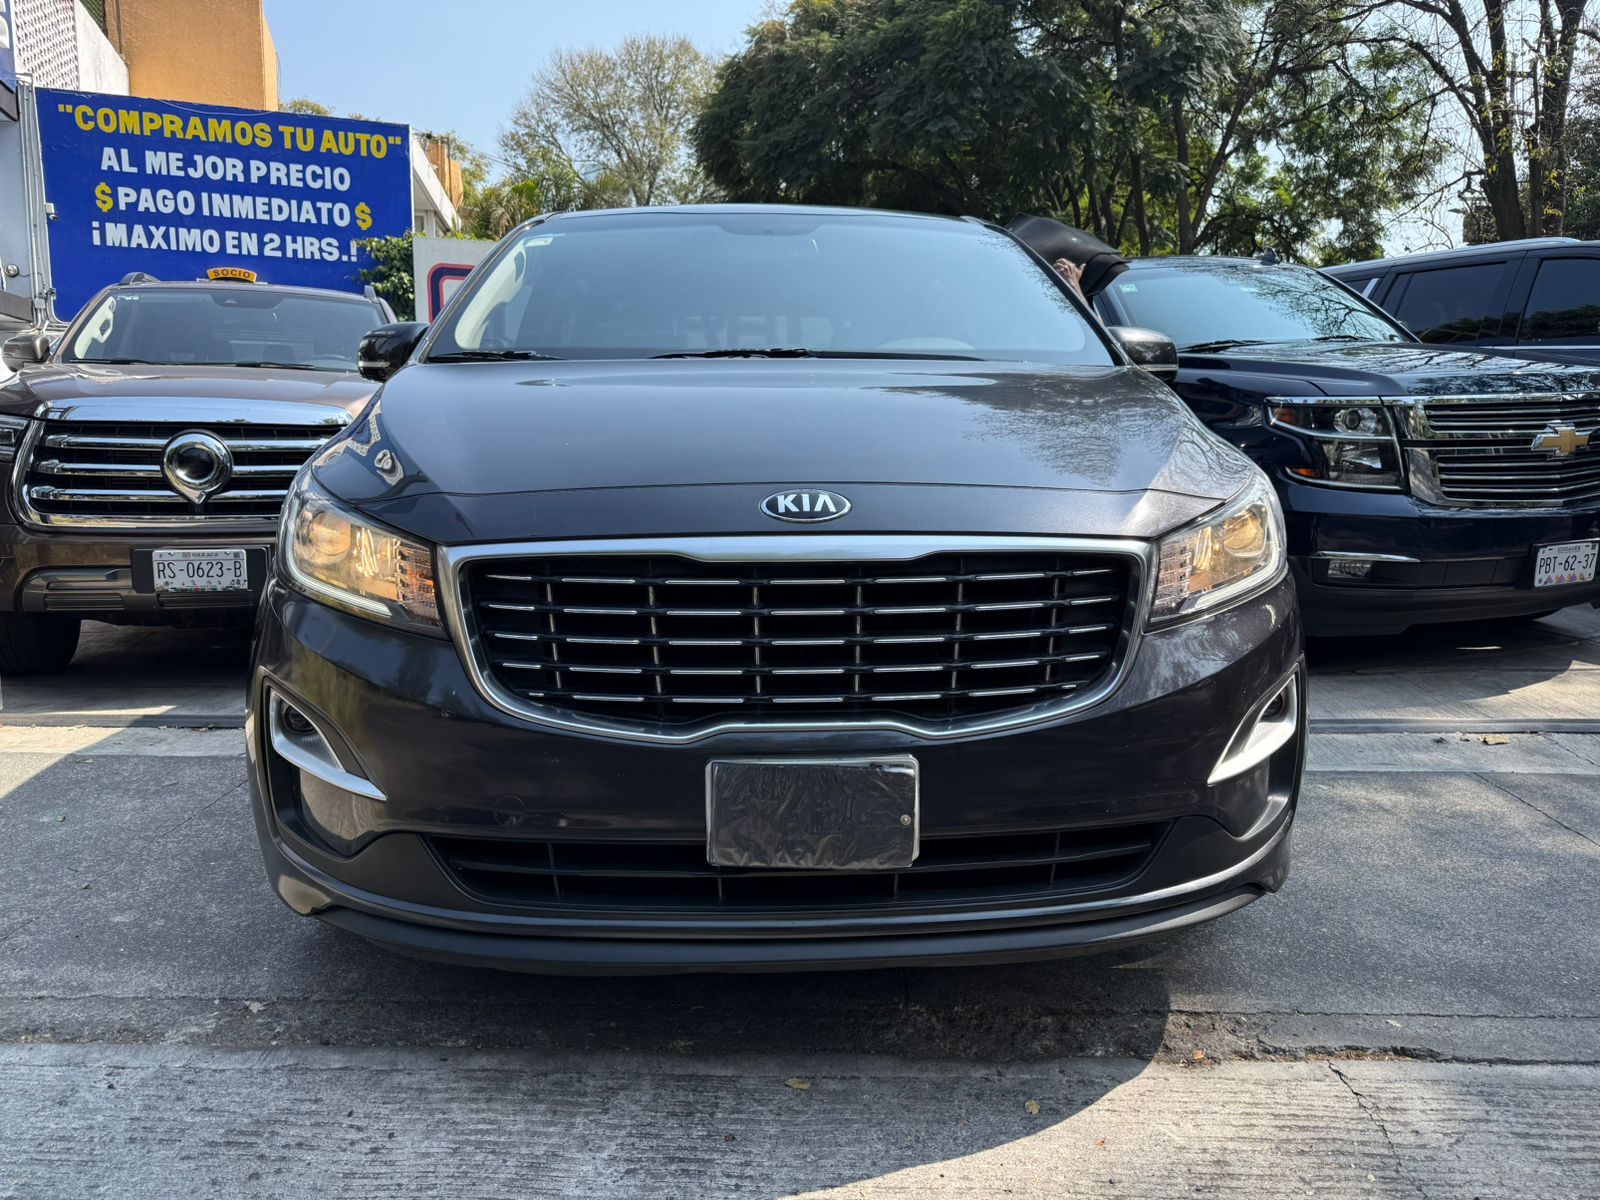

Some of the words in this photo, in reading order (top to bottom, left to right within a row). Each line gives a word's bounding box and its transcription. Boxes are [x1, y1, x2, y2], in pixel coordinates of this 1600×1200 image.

[279, 125, 314, 152] TU
[101, 147, 138, 173] AL
[145, 150, 245, 182] MEJOR
[250, 159, 351, 192] PRECIO
[225, 230, 259, 256] EN
[263, 233, 282, 257] 2
[213, 268, 251, 279] SOCIO
[776, 493, 837, 513] KIA
[157, 560, 242, 579] RS-0623-B
[1538, 552, 1596, 575] PBT-62-37
